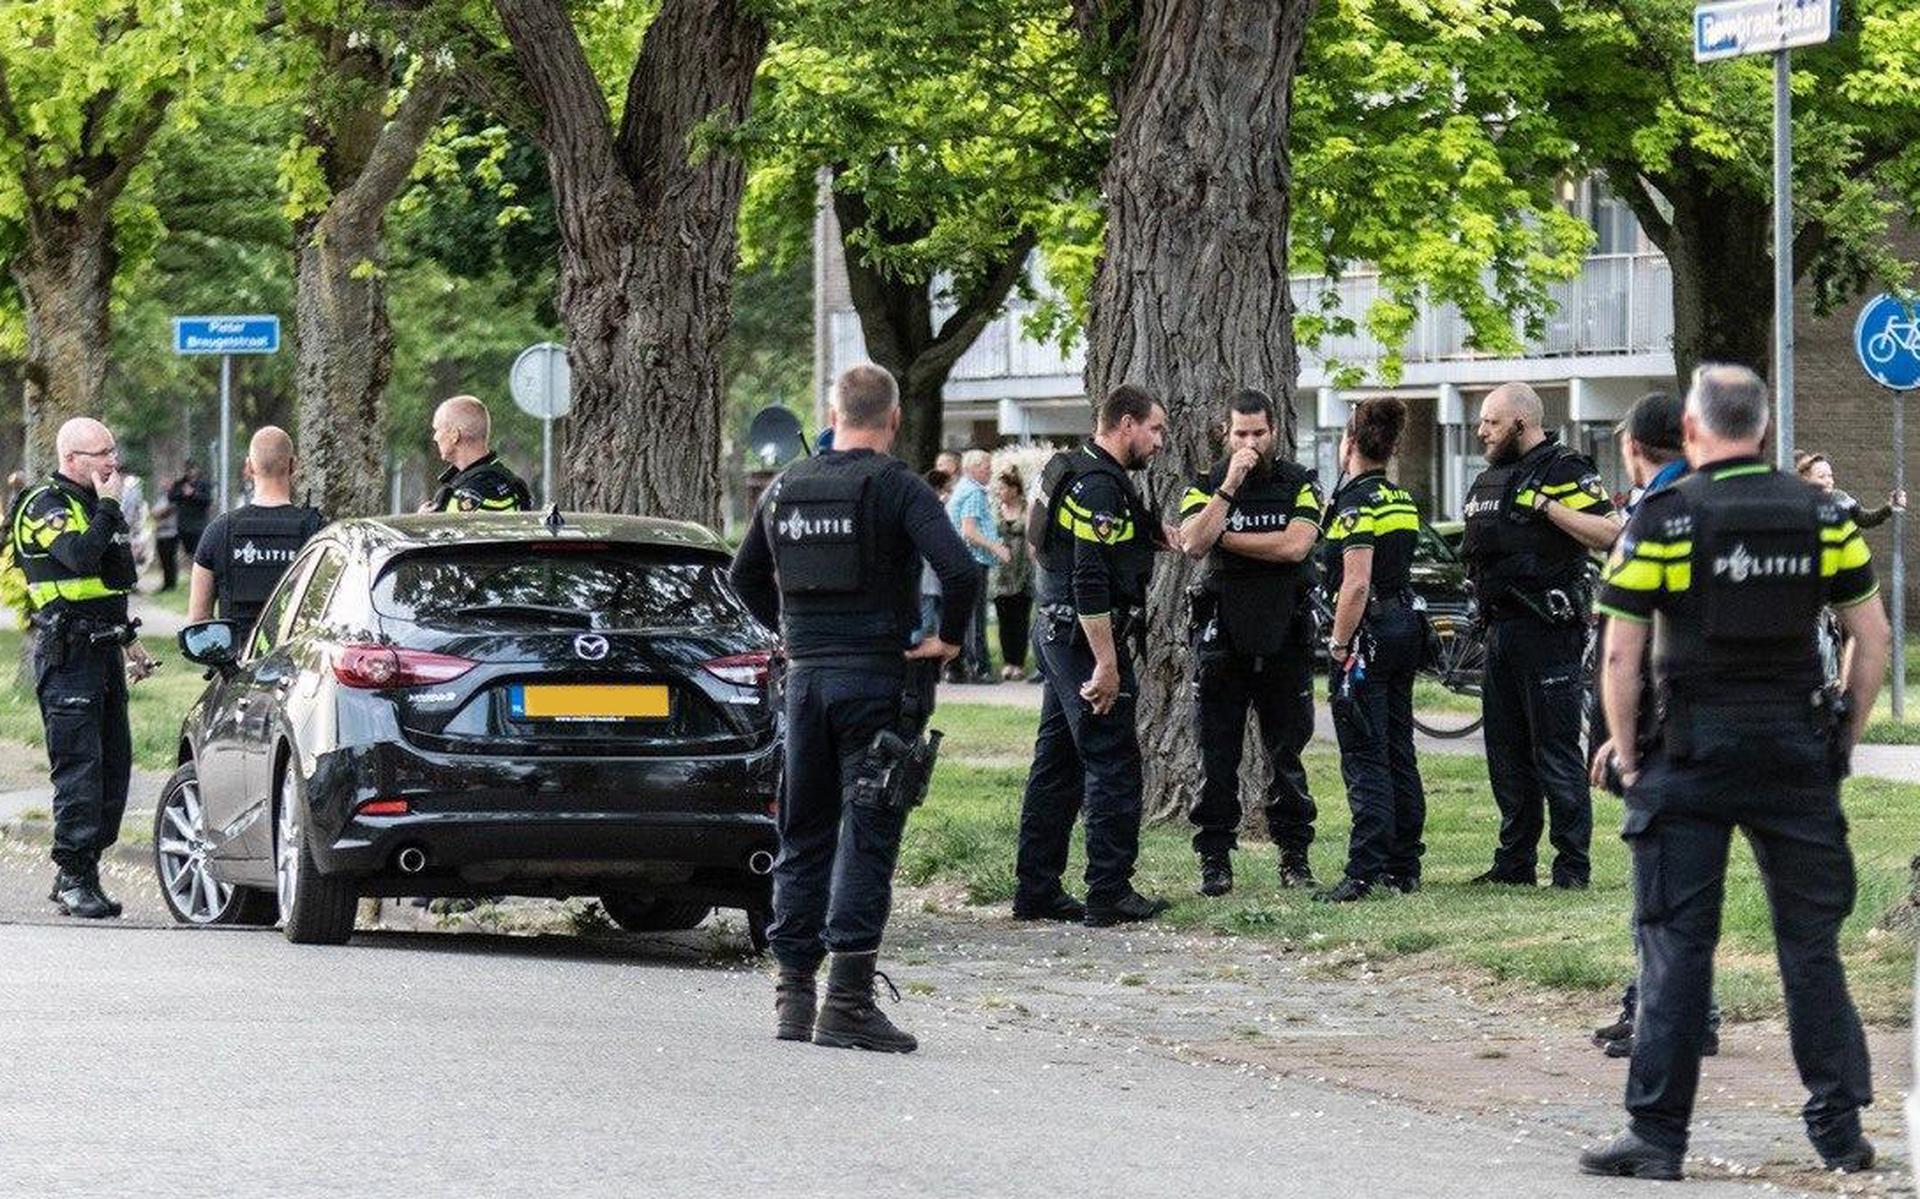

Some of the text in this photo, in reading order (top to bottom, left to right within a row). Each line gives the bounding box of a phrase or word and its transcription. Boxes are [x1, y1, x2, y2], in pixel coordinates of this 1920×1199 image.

[779, 506, 853, 540] POLITIE
[1223, 507, 1287, 531] POLITIE
[233, 540, 297, 564] POLITIE
[1713, 543, 1811, 581] POLITIE
